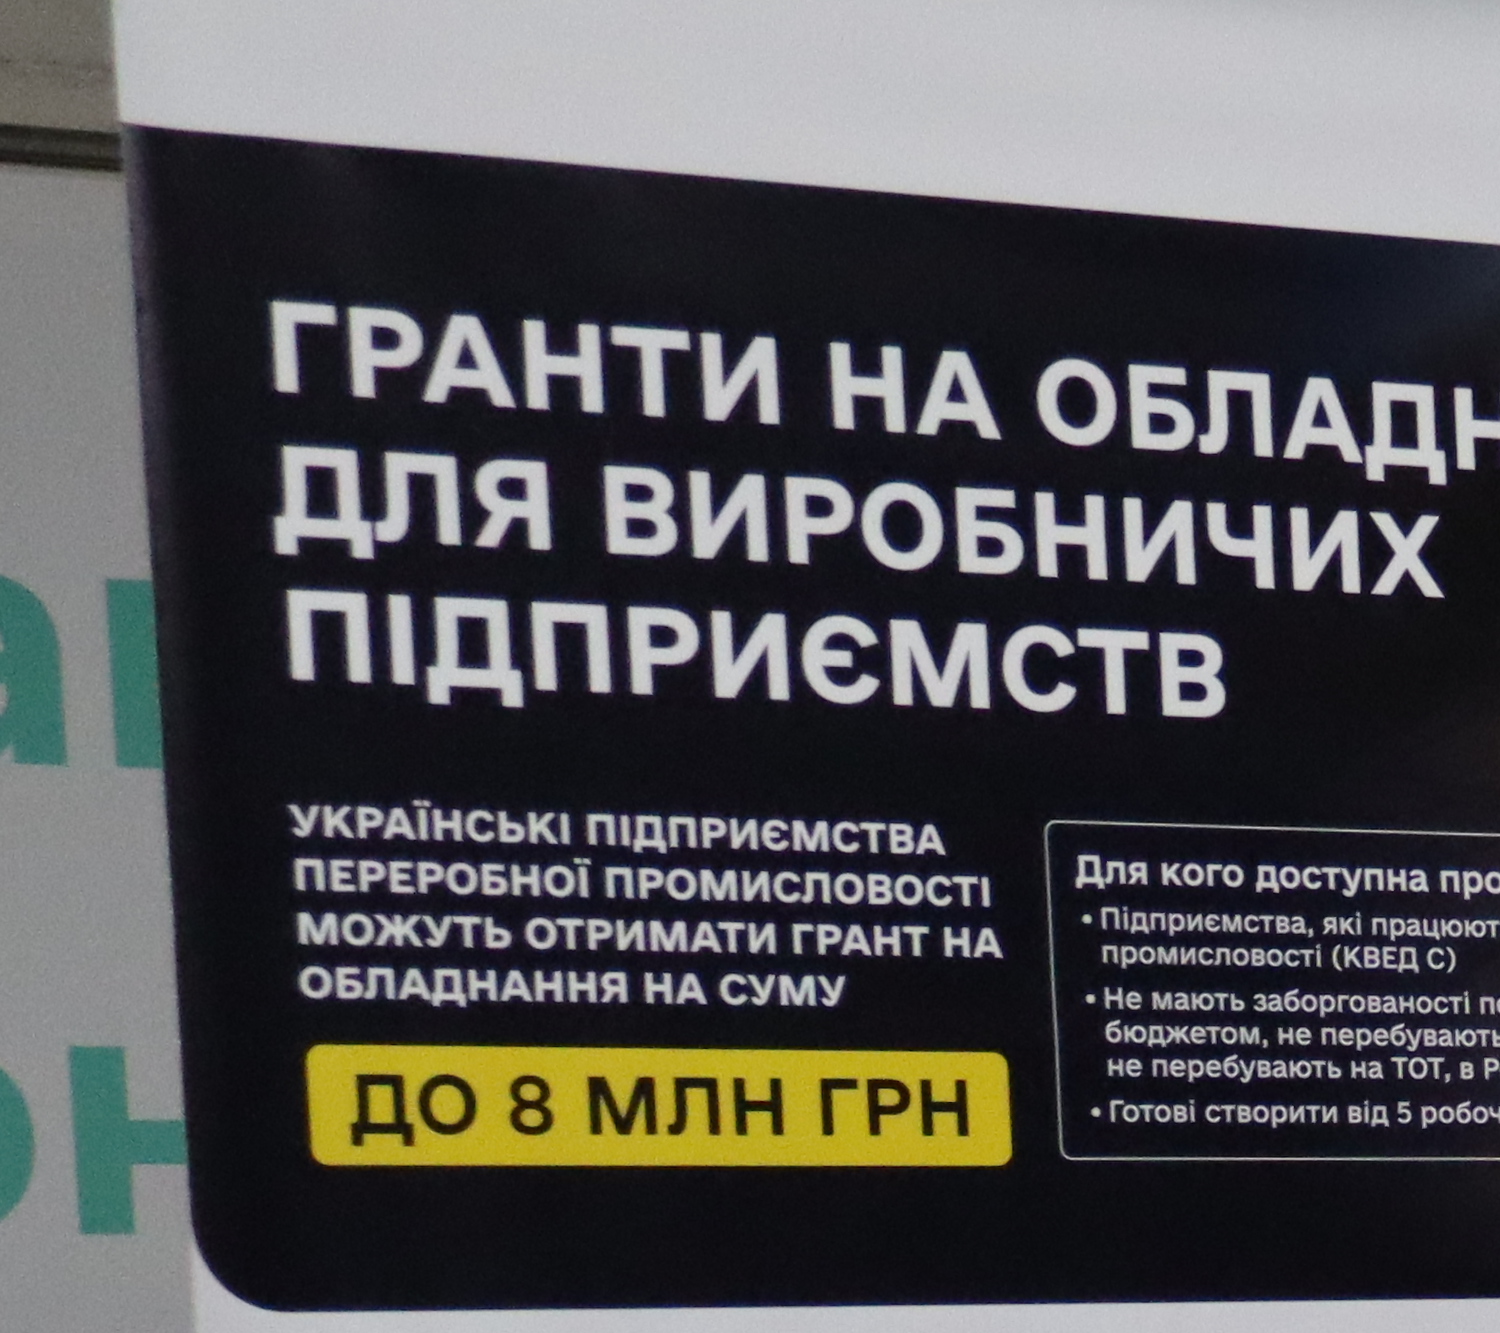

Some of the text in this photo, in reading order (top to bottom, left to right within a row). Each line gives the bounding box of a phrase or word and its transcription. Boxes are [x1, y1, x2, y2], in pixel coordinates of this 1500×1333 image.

[270, 300, 780, 424] ГРАНТИ
[829, 342, 1001, 440] НА
[273, 445, 1444, 598] ДЛЯ ВИРОБНИЧИХ
[286, 589, 1226, 718] ПІДПРИЄМСТВ
[288, 800, 946, 855] УКРАЇНСЬКІ ПІДПРИЄМСТВА
[294, 857, 990, 907] ПЕРЕРОБНОЇ ПРОМИСЛОВОСТІ
[1075, 854, 1148, 889] Для
[1161, 863, 1244, 887] кого
[1256, 865, 1429, 897] доступна
[297, 912, 1003, 958] МОЖУТЬ ОТРИМАТИ ГРАНТ НА
[298, 966, 845, 1007] ОБЛАДНАННЯ НА СУМУ
[350, 1074, 969, 1146] ДО 8 МЛН ГРН
[1110, 1099, 1195, 1123] Готові
[1205, 1104, 1338, 1128] створити
[1348, 1100, 1389, 1127] від
[1397, 1101, 1412, 1124] 5
